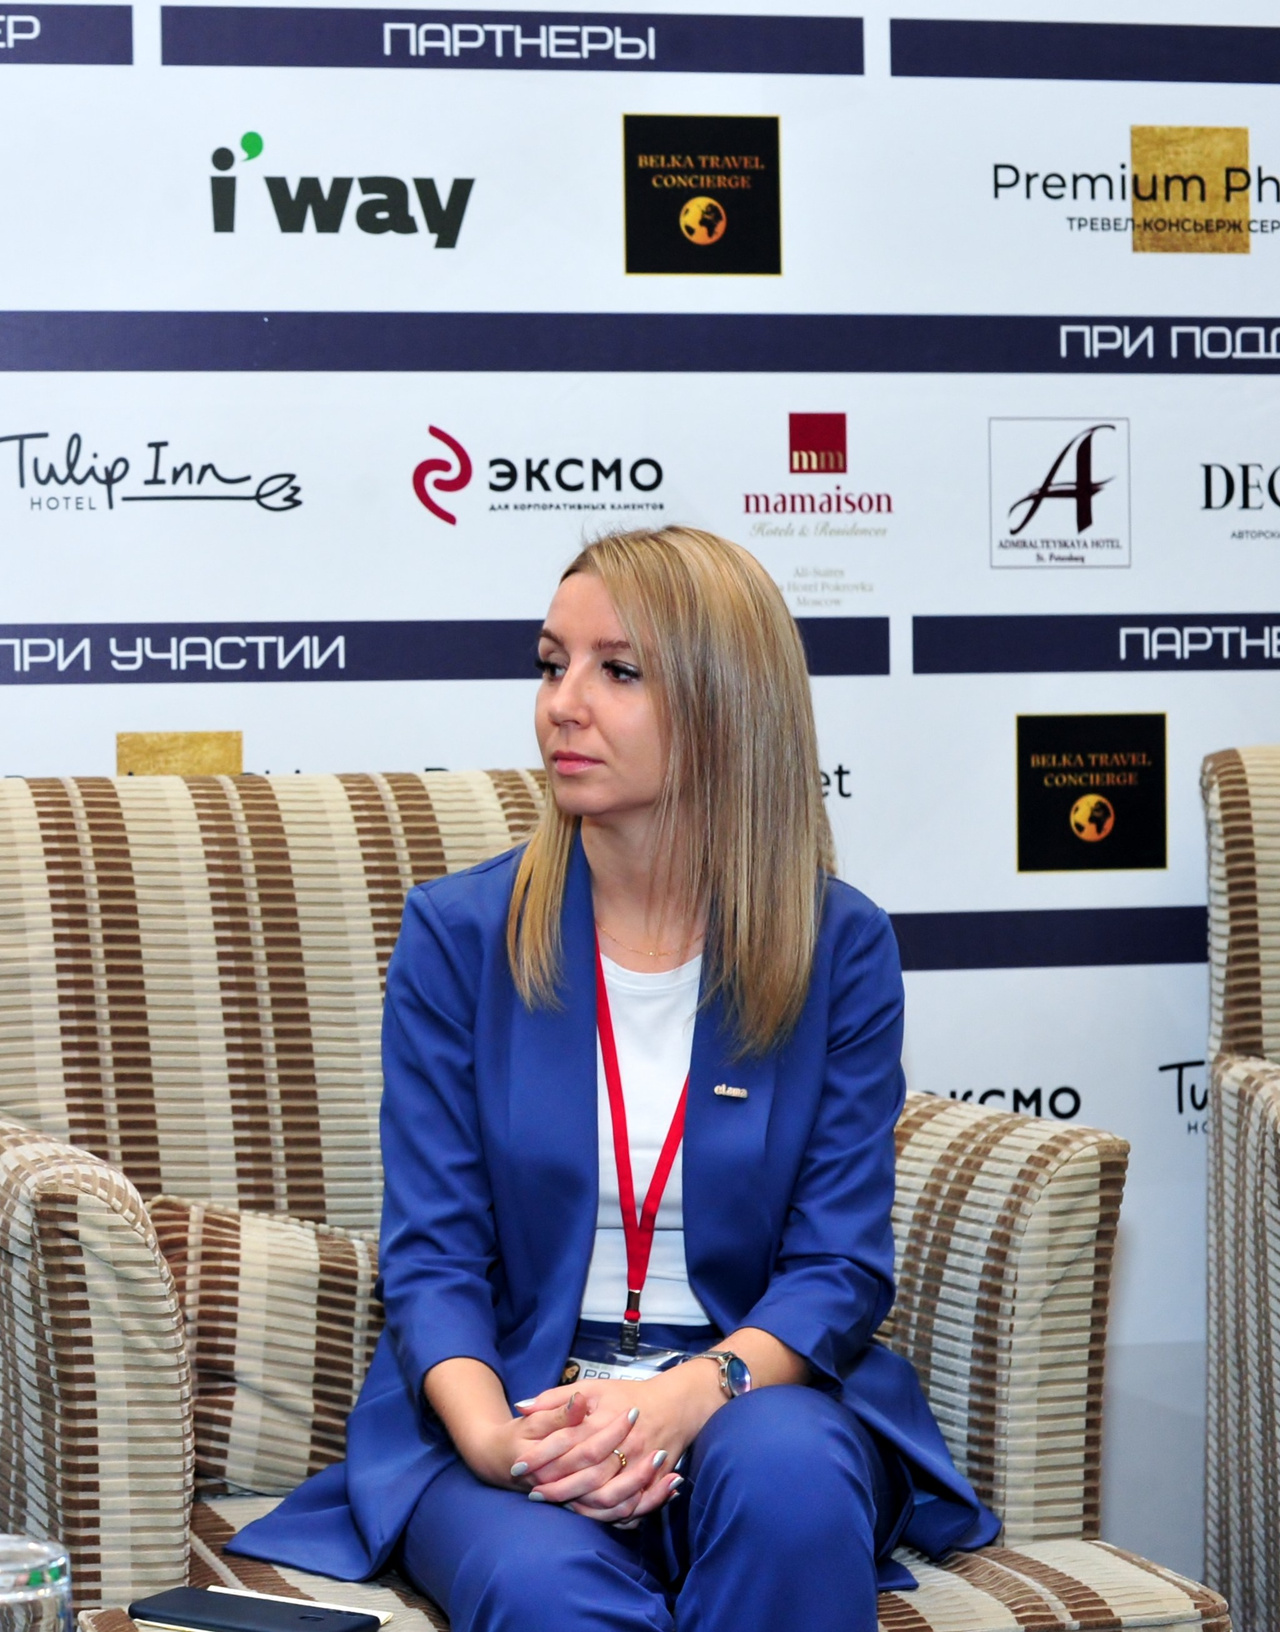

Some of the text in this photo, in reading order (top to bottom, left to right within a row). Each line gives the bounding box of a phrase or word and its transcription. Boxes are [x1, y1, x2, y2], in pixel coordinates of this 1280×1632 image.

[383, 22, 656, 60] ПАРТНЕРЫ
[637, 154, 766, 171] BELKA TRAVEL
[651, 174, 752, 190] CONCIERGE
[993, 163, 1206, 203] Premium
[1066, 217, 1243, 234] ТРЕВЕЛ-КОНСЬЕРЖ
[1060, 324, 1154, 358] ПРИ
[143, 441, 252, 486] Inn
[489, 457, 663, 492] ЭКСМО
[30, 497, 97, 511] HOTEL
[743, 484, 893, 515] mamaison
[110, 635, 346, 671] УЧАСТИИ
[1030, 752, 1152, 768] BELKA TRAVEL
[1043, 770, 1139, 787] CONCIERGE
